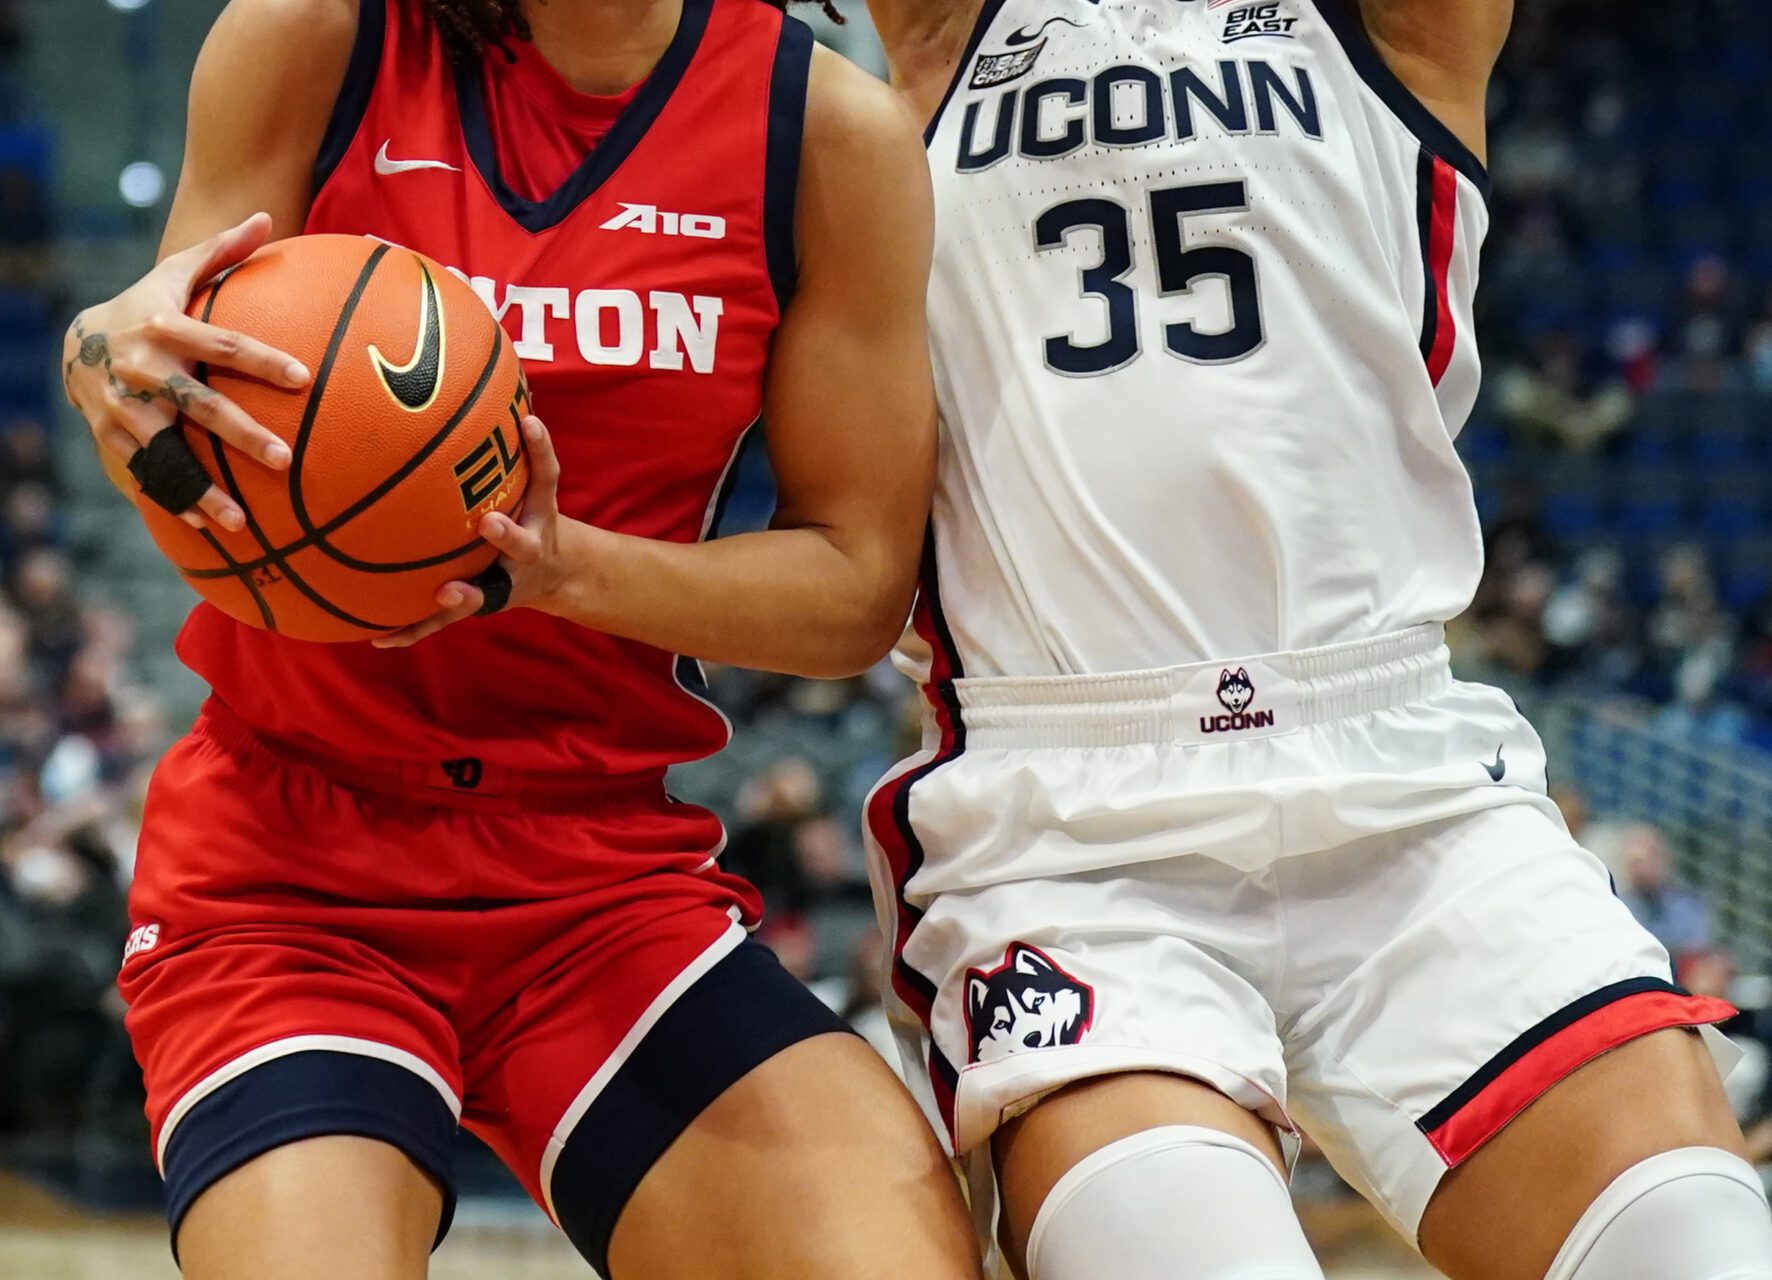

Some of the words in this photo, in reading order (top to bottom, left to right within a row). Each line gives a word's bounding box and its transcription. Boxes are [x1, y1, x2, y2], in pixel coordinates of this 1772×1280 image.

[1223, 18, 1298, 37] EAST
[1226, 1, 1280, 24] BIG
[955, 58, 1325, 175] UCONN
[598, 202, 726, 239] A10
[1031, 176, 1268, 379] 35
[1200, 709, 1274, 733] UCONN
